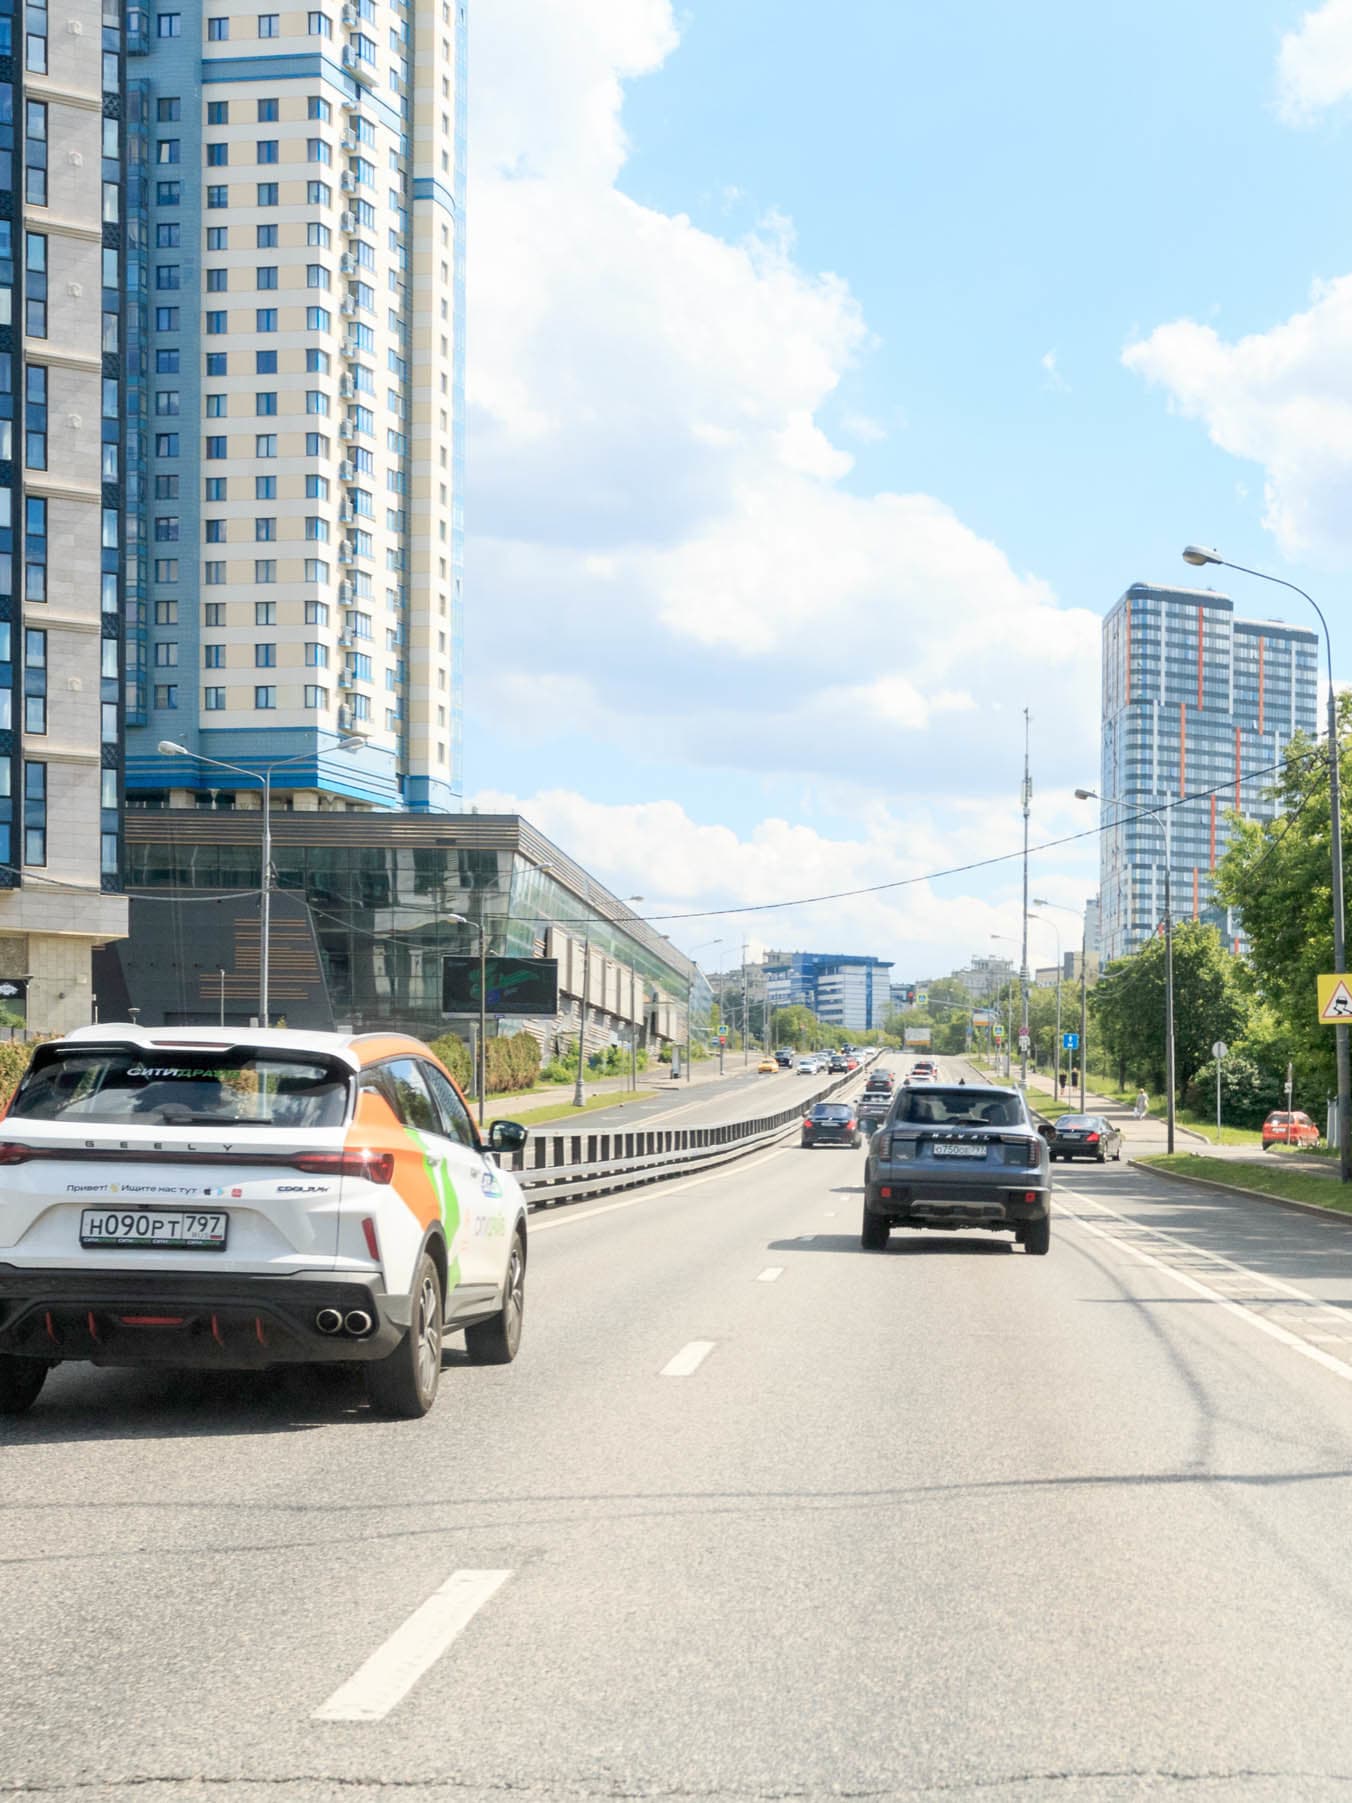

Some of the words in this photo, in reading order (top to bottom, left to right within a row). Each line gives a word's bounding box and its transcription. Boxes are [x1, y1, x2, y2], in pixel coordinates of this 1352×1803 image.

[85, 1140, 233, 1152] GEELY
[66, 1184, 108, 1193] Привет!
[121, 1184, 156, 1193] Ищите
[179, 1186, 198, 1195] тут
[186, 1215, 221, 1233] 797
